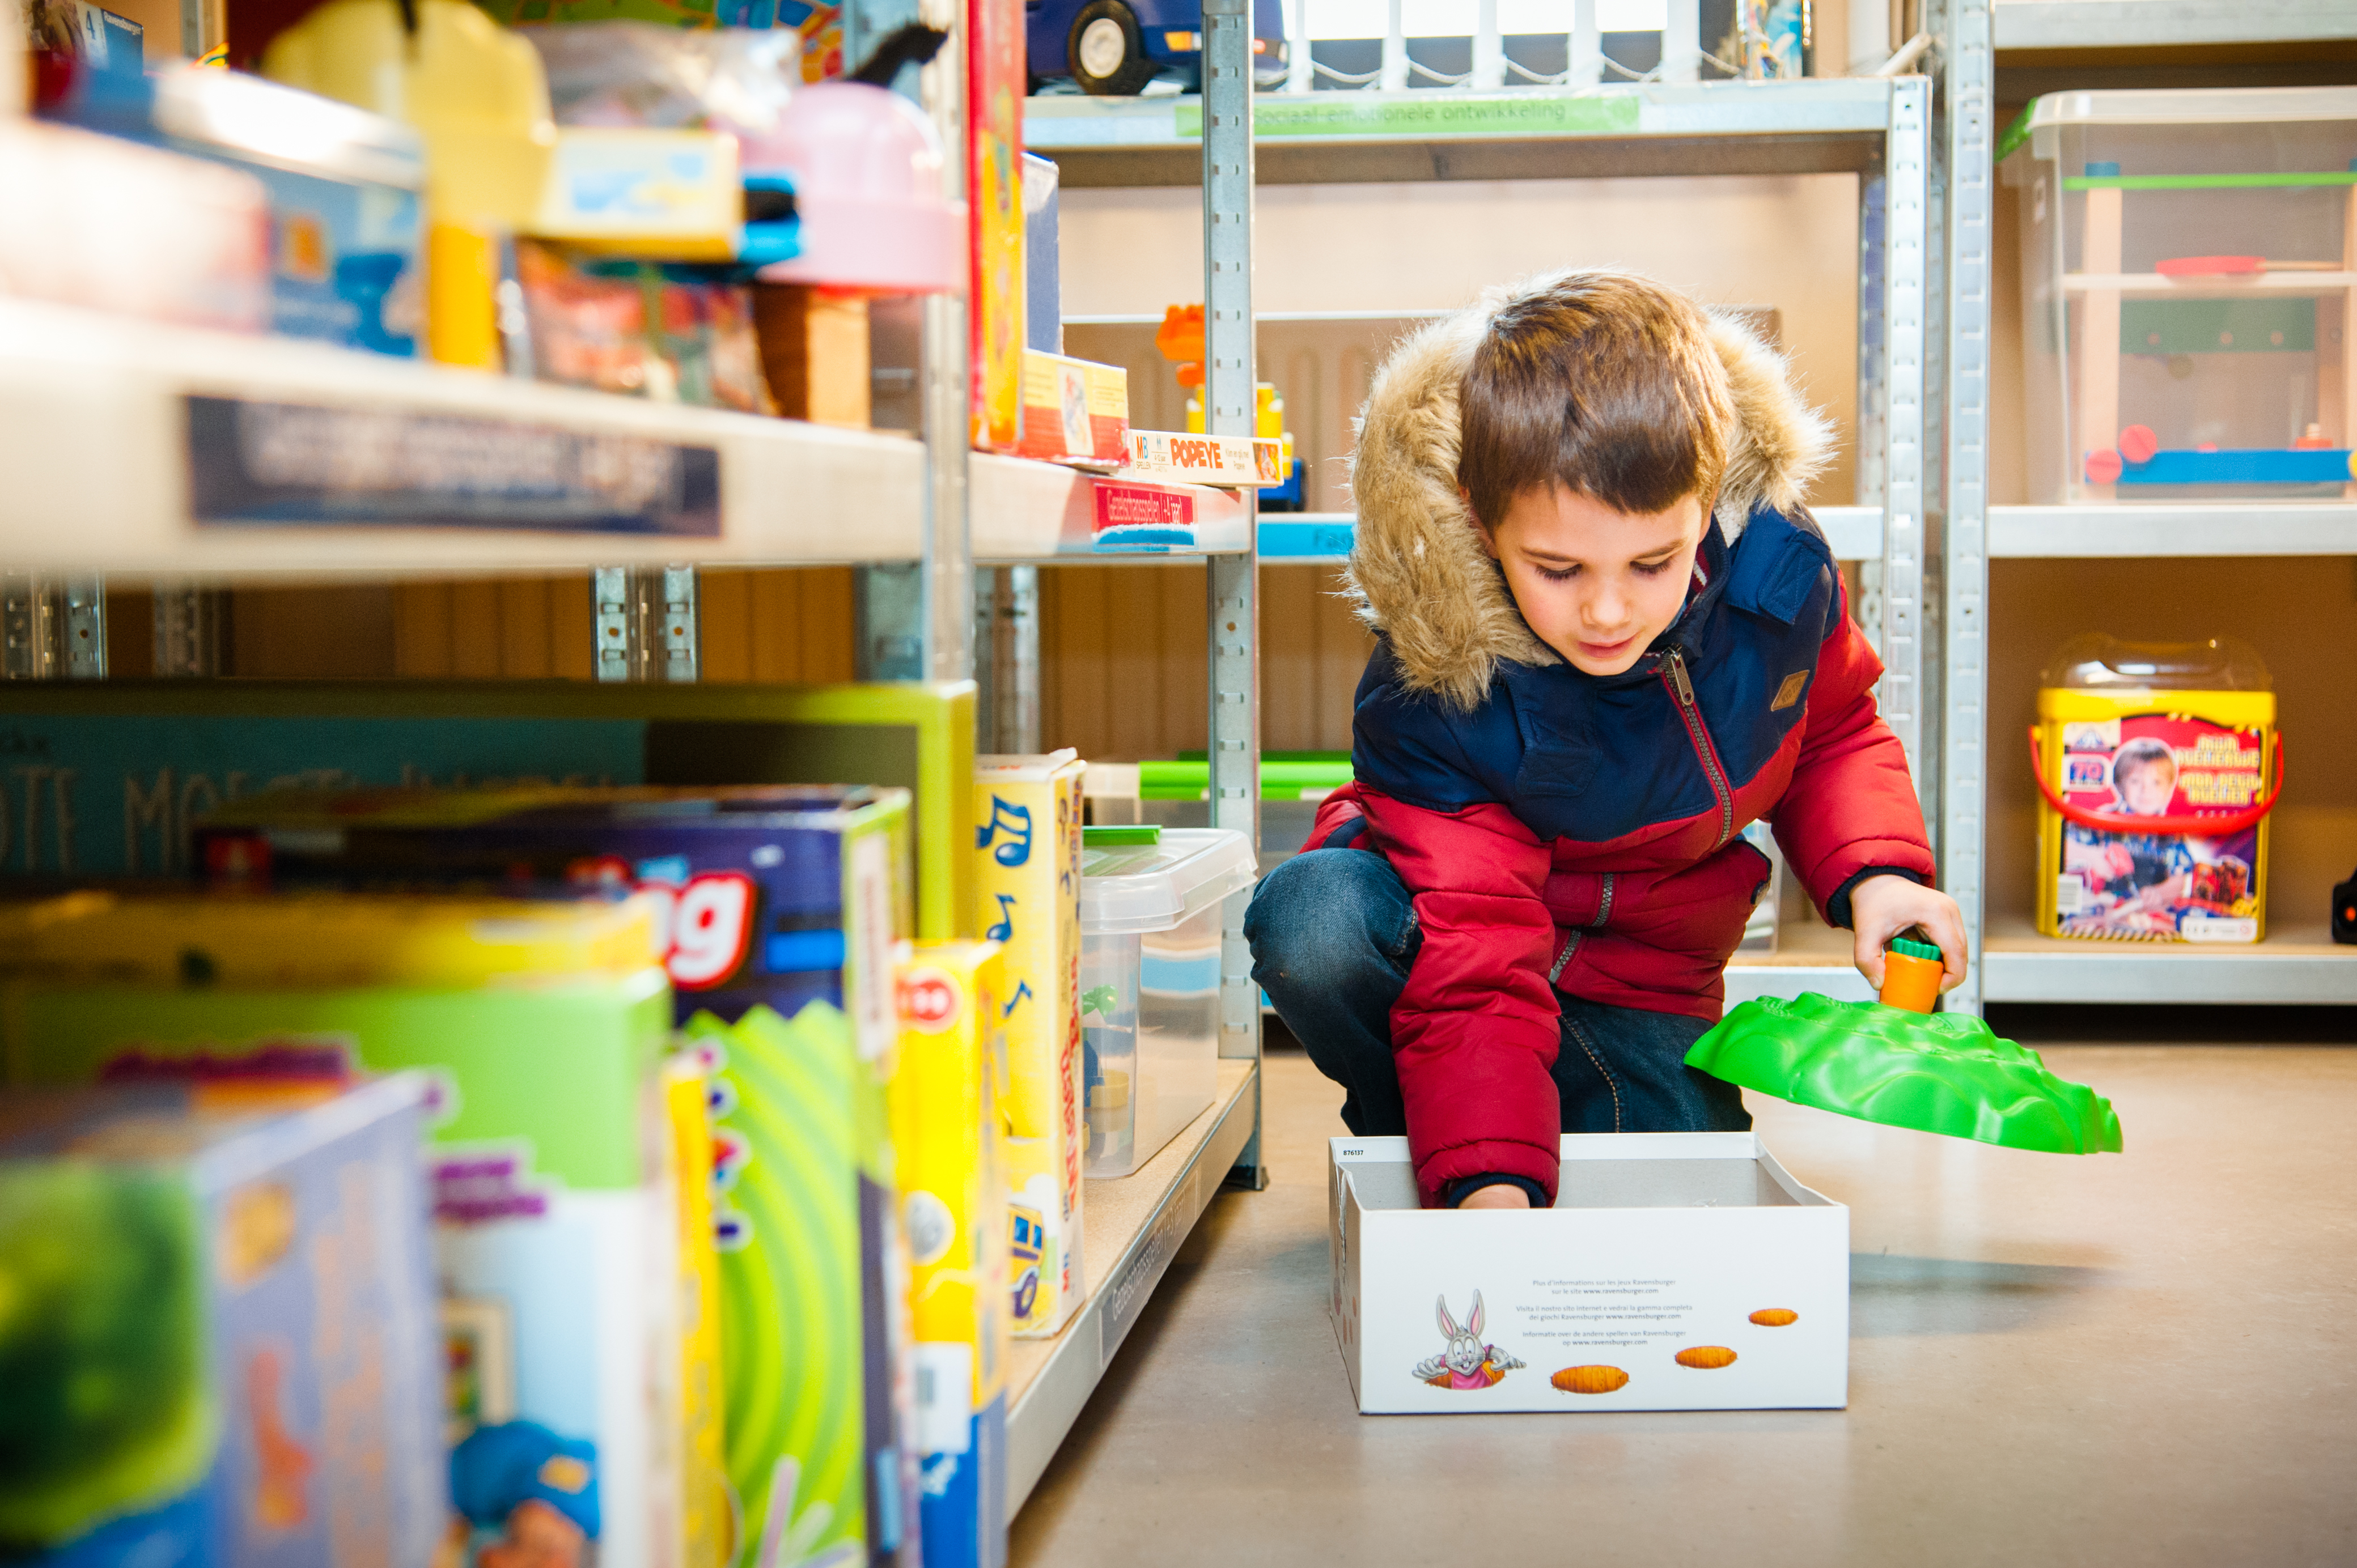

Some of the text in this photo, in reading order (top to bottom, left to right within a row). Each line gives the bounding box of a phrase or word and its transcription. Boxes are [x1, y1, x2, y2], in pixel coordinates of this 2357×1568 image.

[86, 10, 96, 40] 4
[1440, 101, 1566, 124] ontwikkeling
[1136, 436, 1148, 460] MB
[1170, 438, 1223, 469] POPEYE
[1136, 461, 1151, 470] SPELLEN
[1233, 460, 1245, 471] Popeye
[2074, 762, 2102, 779] 70
